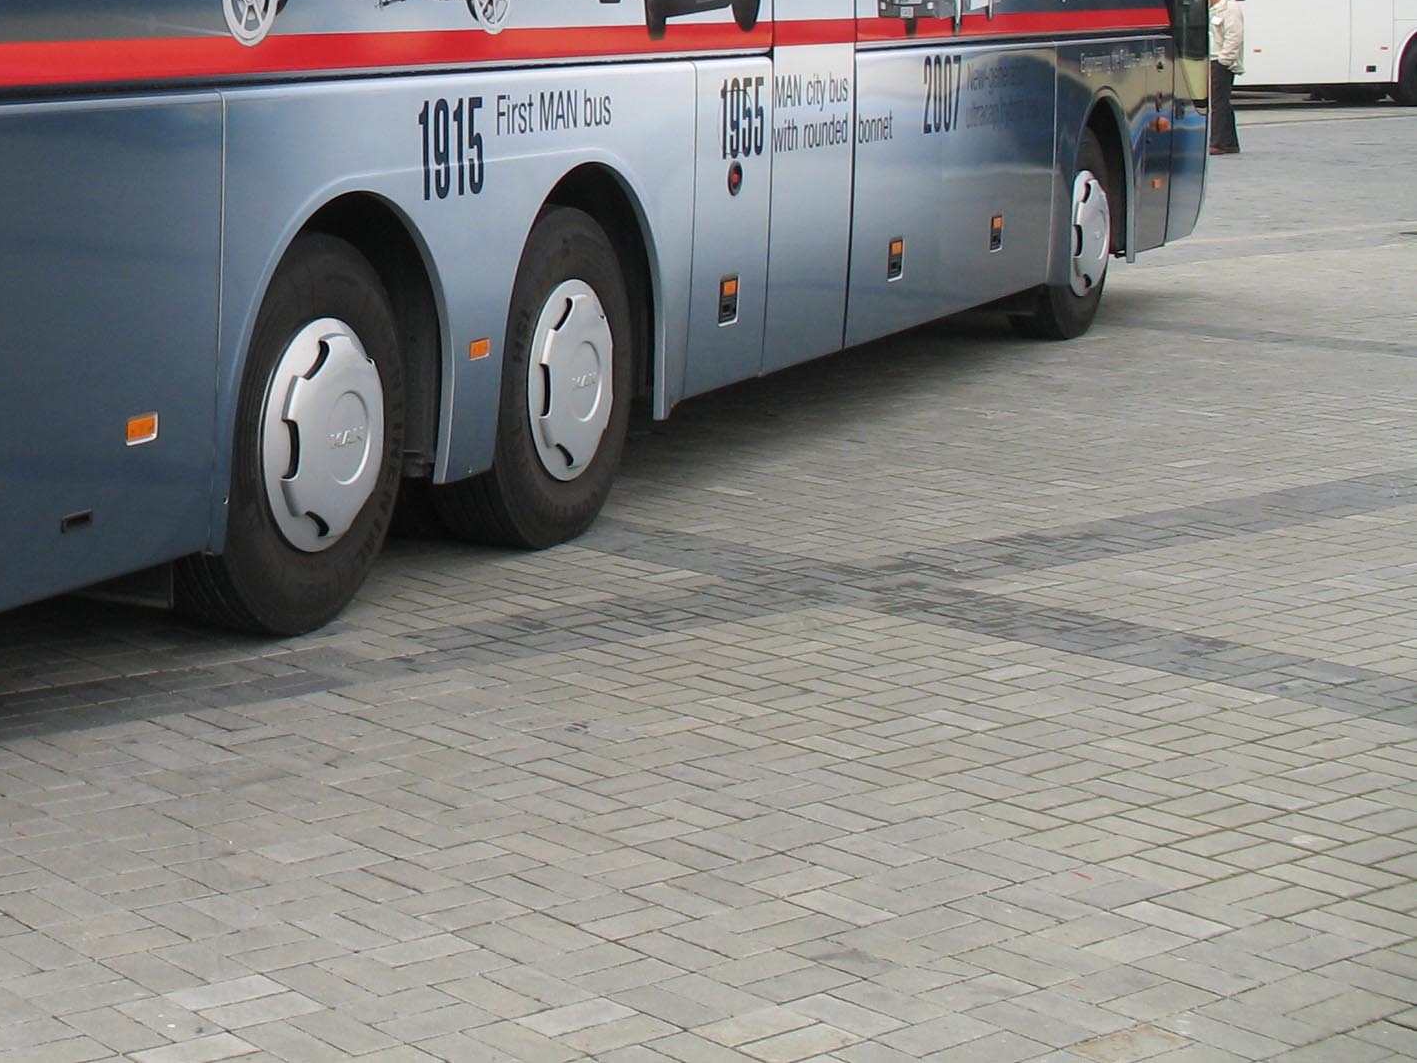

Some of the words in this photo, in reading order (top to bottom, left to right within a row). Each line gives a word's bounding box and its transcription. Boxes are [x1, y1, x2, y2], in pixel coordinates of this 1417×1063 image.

[720, 76, 765, 160] 1955
[774, 74, 802, 109] MAN
[806, 72, 827, 111] city
[828, 70, 849, 103] bus
[773, 117, 799, 153] with
[802, 111, 849, 150] rounded
[857, 109, 894, 145] bonnet
[922, 53, 962, 135] 2007
[418, 96, 484, 201] 1915
[495, 93, 534, 136] First
[538, 88, 578, 132] MAN
[583, 88, 612, 128] bus
